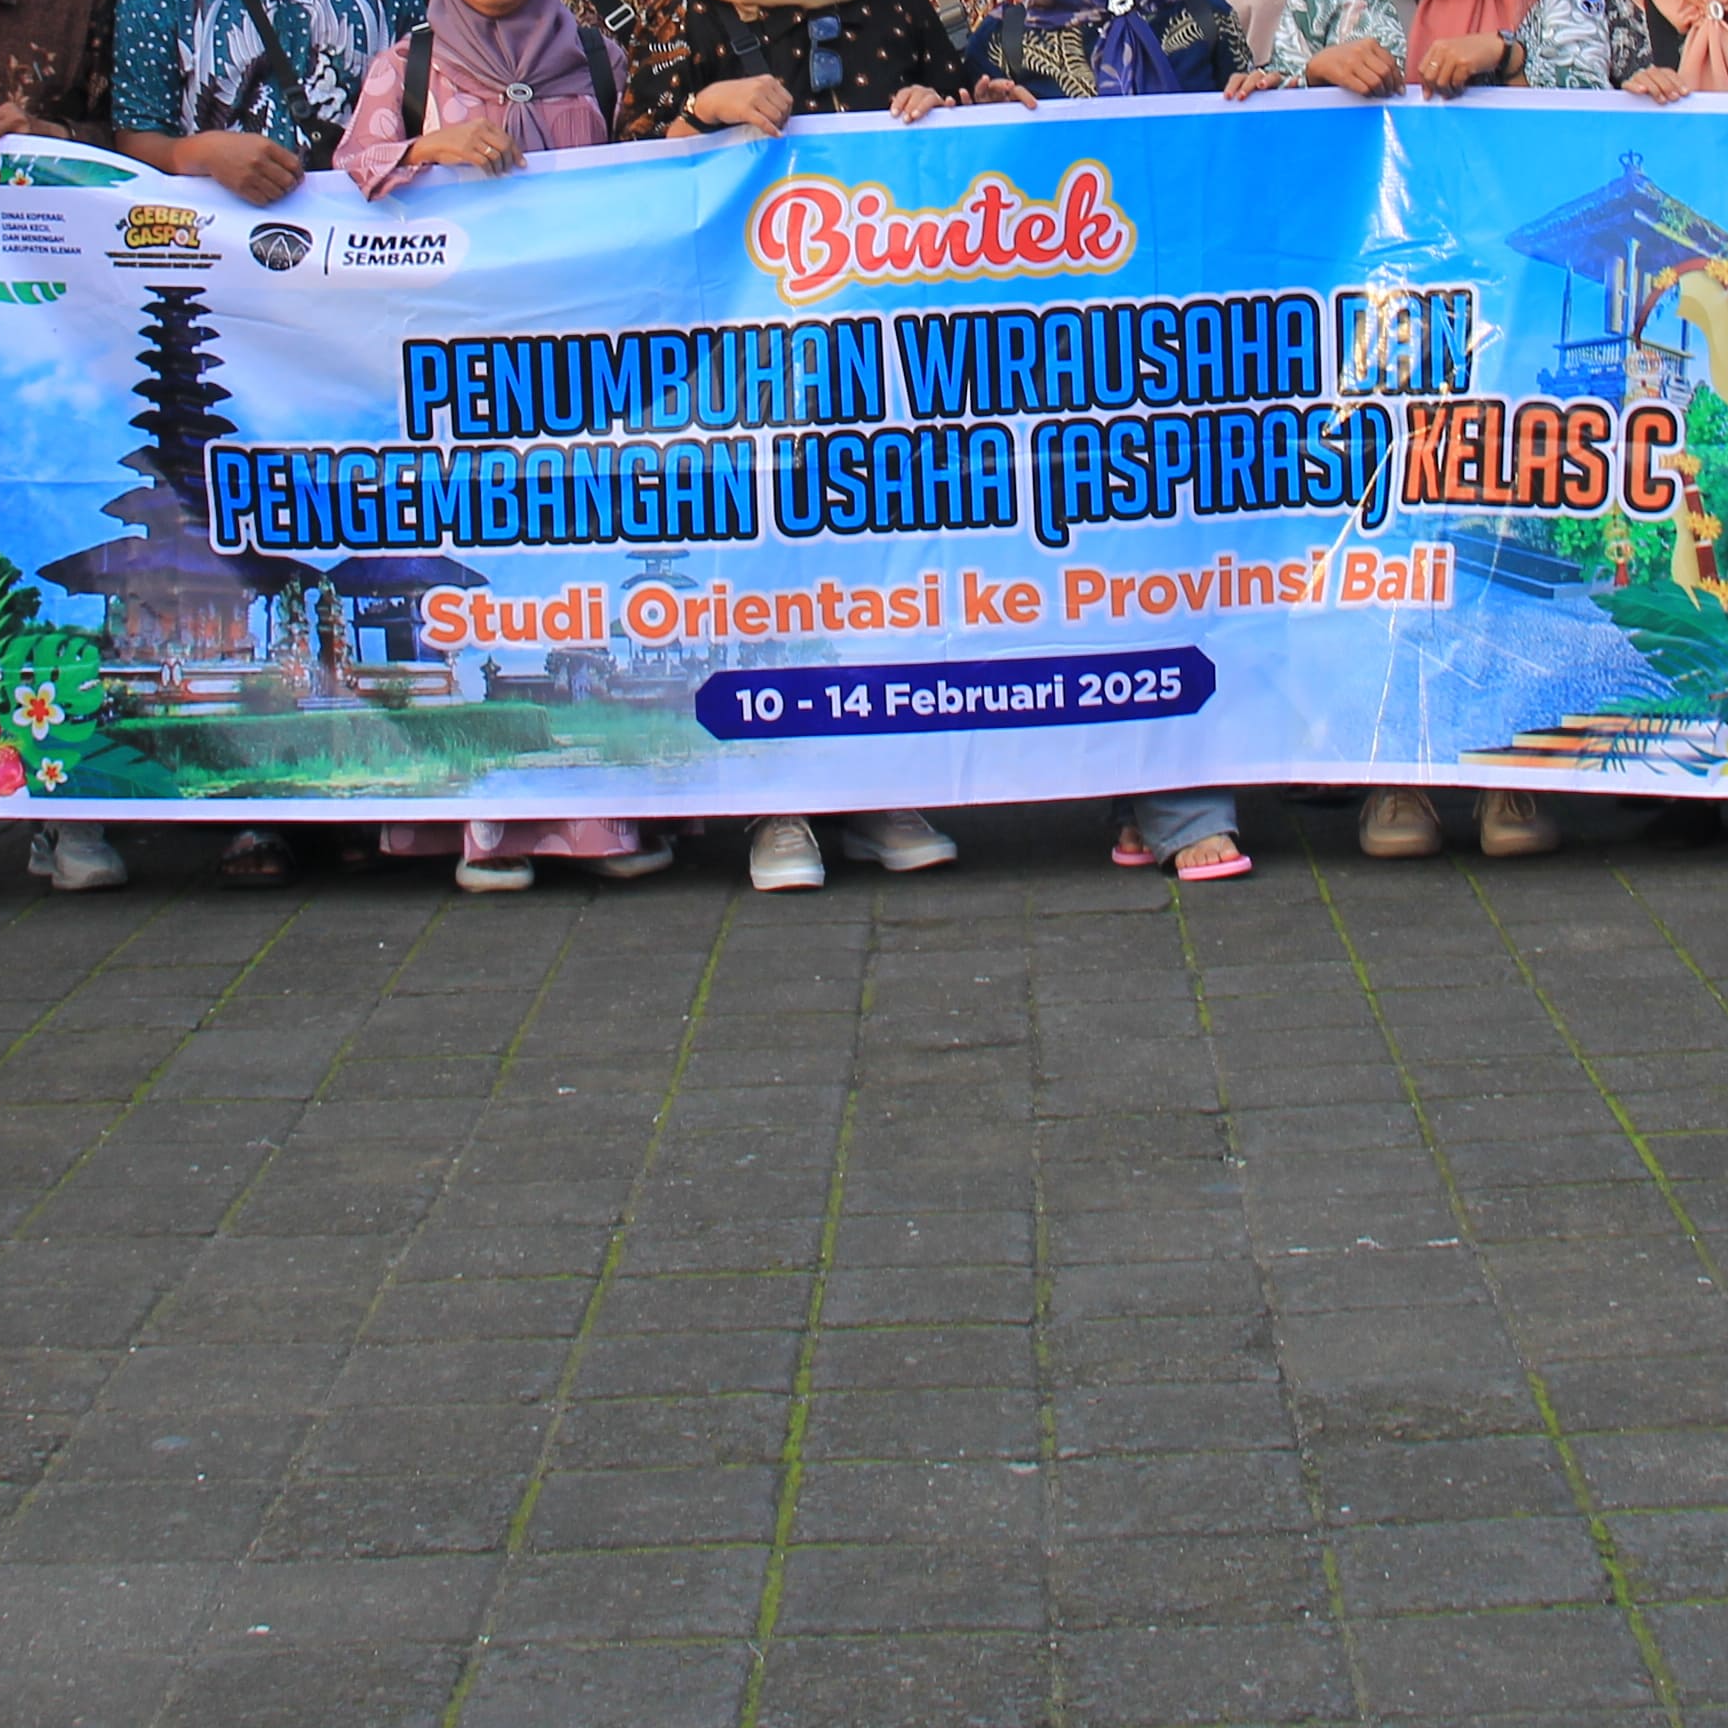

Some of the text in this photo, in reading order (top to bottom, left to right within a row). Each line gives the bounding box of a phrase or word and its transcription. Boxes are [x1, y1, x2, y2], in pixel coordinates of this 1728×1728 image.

[1, 212, 25, 220] DINAS
[129, 205, 197, 226] GEBER
[2, 223, 28, 231] USAHA
[124, 225, 201, 249] GASPOL
[757, 171, 1124, 293] Bimtek
[2, 245, 82, 255] KABUPATEN SLEMAN
[347, 233, 448, 251] UMKM
[342, 249, 446, 267] SEMBADA
[403, 289, 1473, 440] PENUMBUHAN WIRAUSAHA DAN
[210, 400, 1679, 550] PENGEMBANGAN USAHA (ASPIRASI) KELAS C
[427, 548, 1448, 644] Studi Orientasi ke Provinsi Bali
[735, 666, 1183, 723] 10 - 14 Februari 2025
